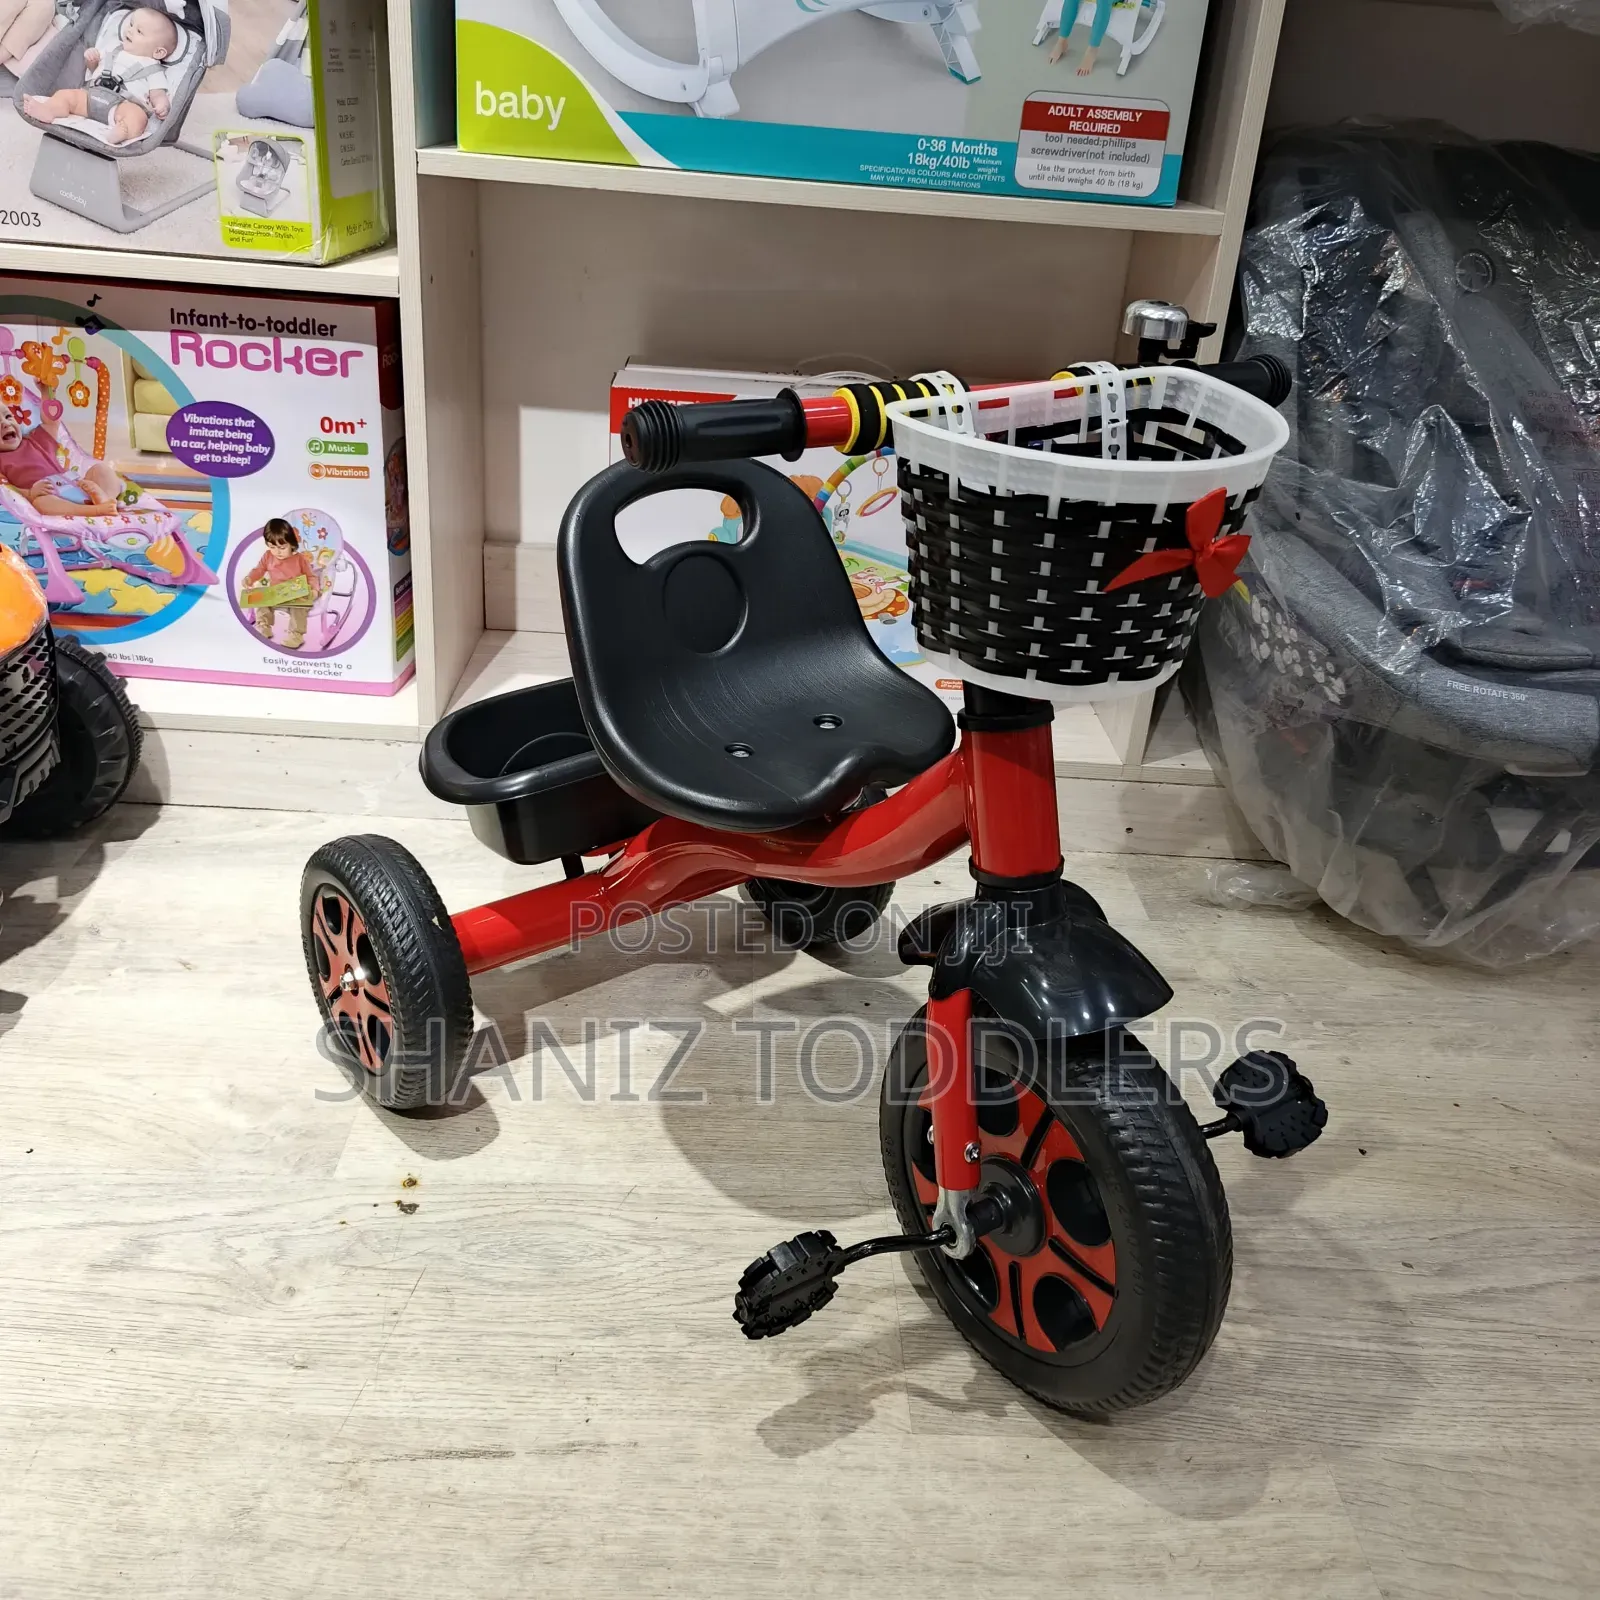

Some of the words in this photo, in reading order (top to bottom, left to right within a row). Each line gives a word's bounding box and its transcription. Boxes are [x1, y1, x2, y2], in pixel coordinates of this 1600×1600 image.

[475, 80, 566, 131] baby
[1048, 105, 1084, 117] ADULT
[1087, 109, 1142, 122] ASSEMBLY
[1069, 121, 1121, 134] REQUIRED
[1045, 133, 1063, 143] tool
[917, 138, 946, 152] 0-36
[951, 141, 998, 156] Months
[907, 152, 970, 169] 18kg/40lb
[972, 157, 1002, 165] Maximum
[1109, 151, 1150, 164] included)
[859, 164, 916, 175] SPECIFICATIONS
[917, 169, 951, 178] COLOURS
[968, 173, 1006, 183] CONTENTS
[1037, 164, 1051, 172] Use
[1053, 164, 1065, 173] the
[1068, 166, 1095, 177] product
[1098, 168, 1115, 177] from
[1118, 170, 1135, 178] birth
[886, 175, 904, 183] VARY
[907, 177, 927, 185] FROM
[928, 179, 981, 189] ILLUSTRATIONS
[1029, 173, 1045, 181] until
[1047, 175, 1065, 183] child
[1068, 176, 1093, 186] weighs
[1095, 177, 1105, 185] 40
[1107, 178, 1115, 186] lb
[1118, 179, 1130, 188] (18
[1132, 180, 1143, 190] kg)
[0, 209, 42, 227] 2003
[253, 222, 275, 232] Canopy
[170, 307, 338, 337] Infant-to-toddler
[170, 329, 364, 378] Rocker
[183, 412, 234, 427] Vibrations
[234, 417, 256, 428] that
[189, 426, 225, 438] imitate
[225, 429, 253, 442] being
[170, 437, 181, 447] in
[181, 440, 189, 448] a
[189, 441, 207, 450] car,
[207, 440, 245, 454] helping
[245, 442, 271, 456] baby
[328, 443, 356, 453] Music
[193, 453, 211, 463] get
[211, 454, 222, 463] to
[222, 454, 251, 466] sleep!
[326, 467, 369, 477] Vibrations
[107, 652, 118, 660] 40
[263, 656, 288, 666] Easily
[291, 660, 331, 669] converts
[333, 662, 343, 670] to
[277, 666, 310, 675] toddler
[313, 668, 343, 677] rocker
[1447, 679, 1471, 692] FREE
[1473, 685, 1508, 699] ROTATE
